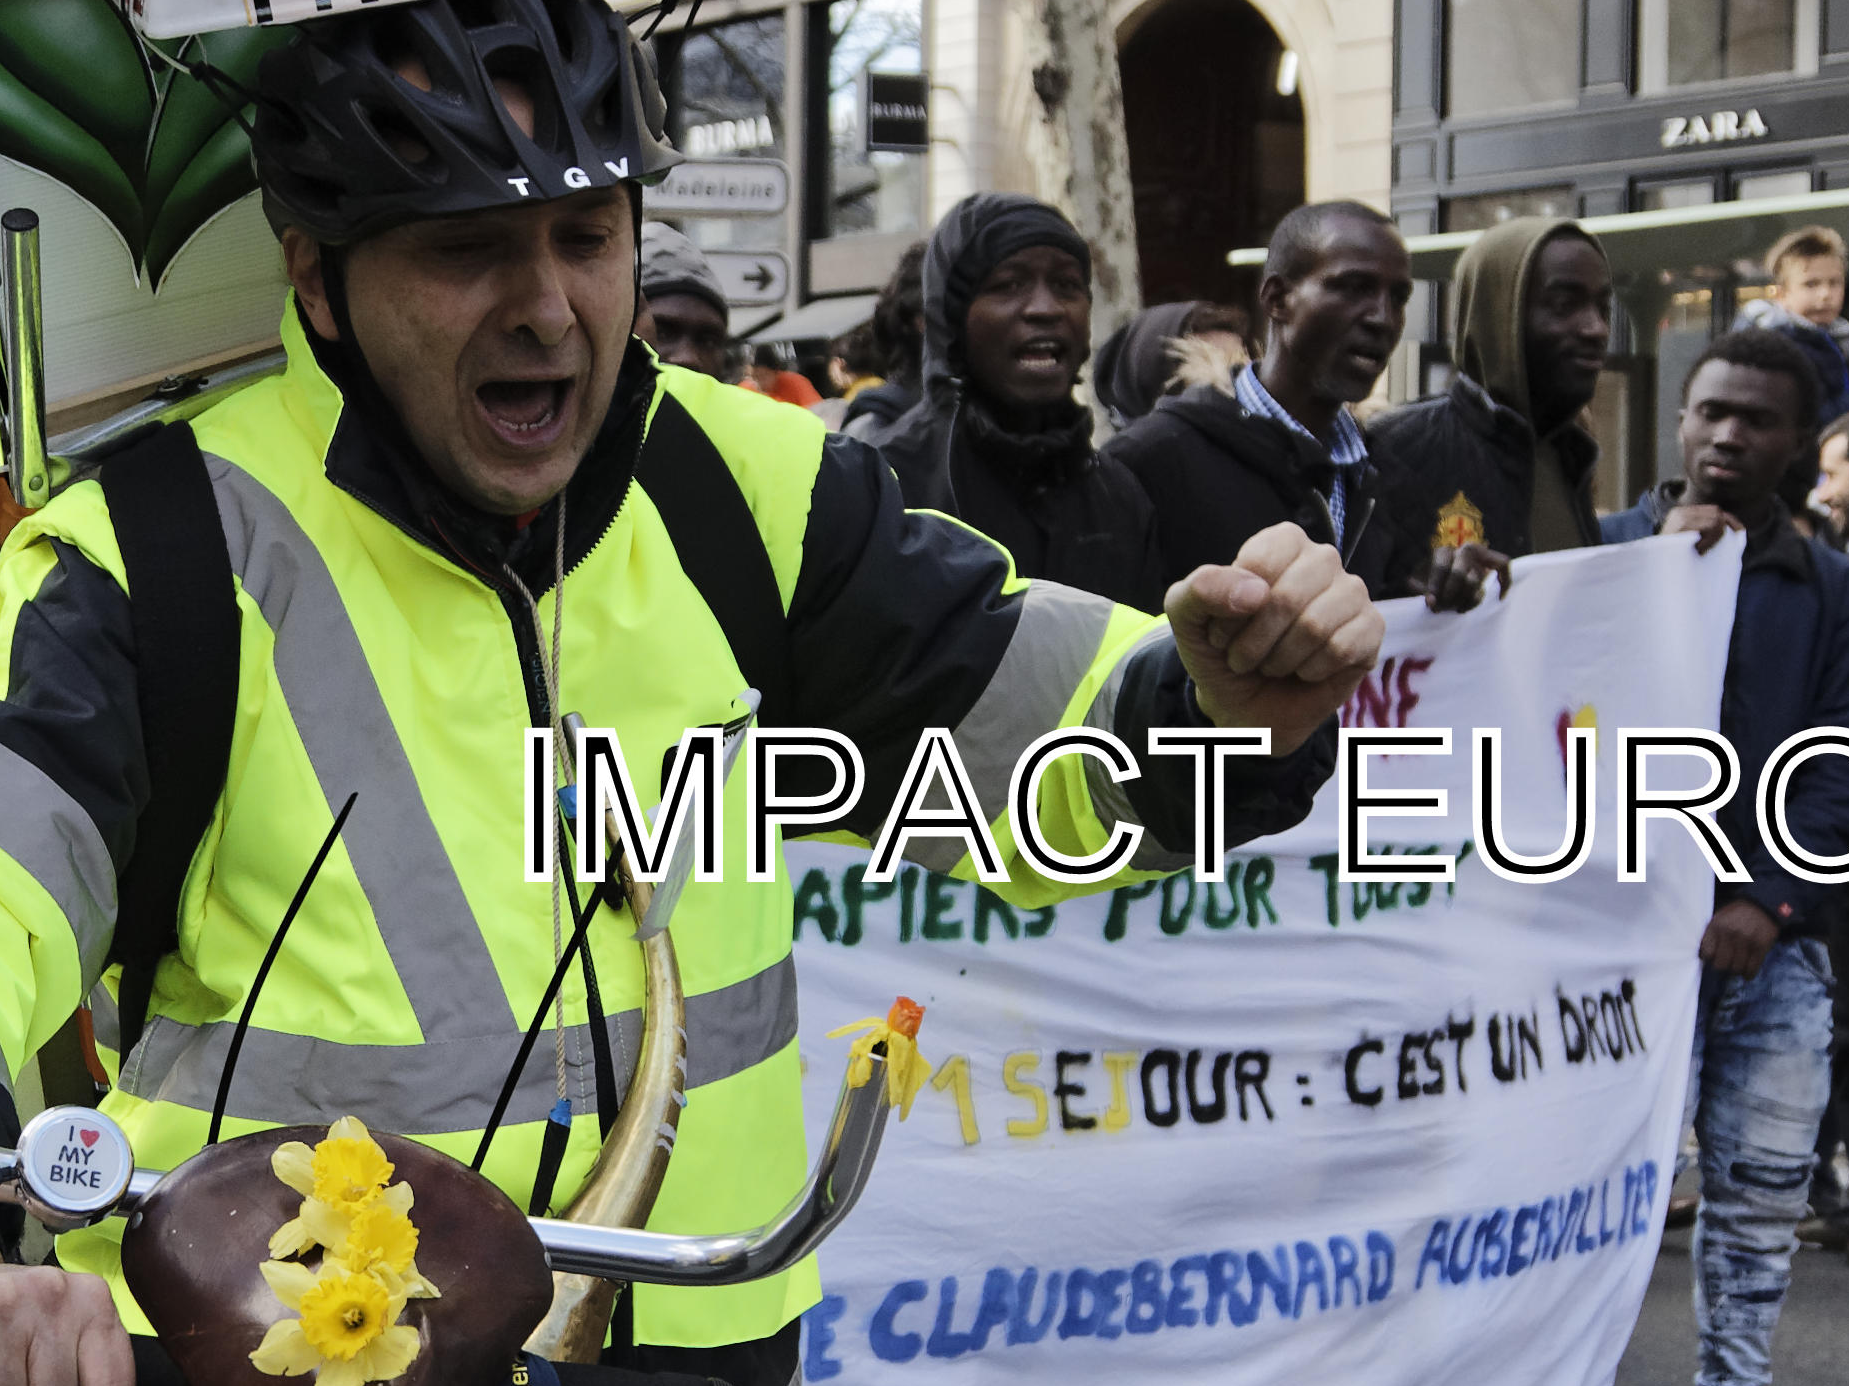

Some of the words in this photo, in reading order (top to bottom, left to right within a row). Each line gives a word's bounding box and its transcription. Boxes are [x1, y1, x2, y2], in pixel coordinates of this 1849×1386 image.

[1661, 108, 1769, 147] ZARA
[654, 176, 777, 199] Madeleine
[1004, 1048, 1275, 1141] SEJOUR
[1487, 1004, 1545, 1082] UN
[1554, 979, 1647, 1064] DROIT
[58, 1144, 95, 1166] MY
[50, 1164, 102, 1189] BIKE
